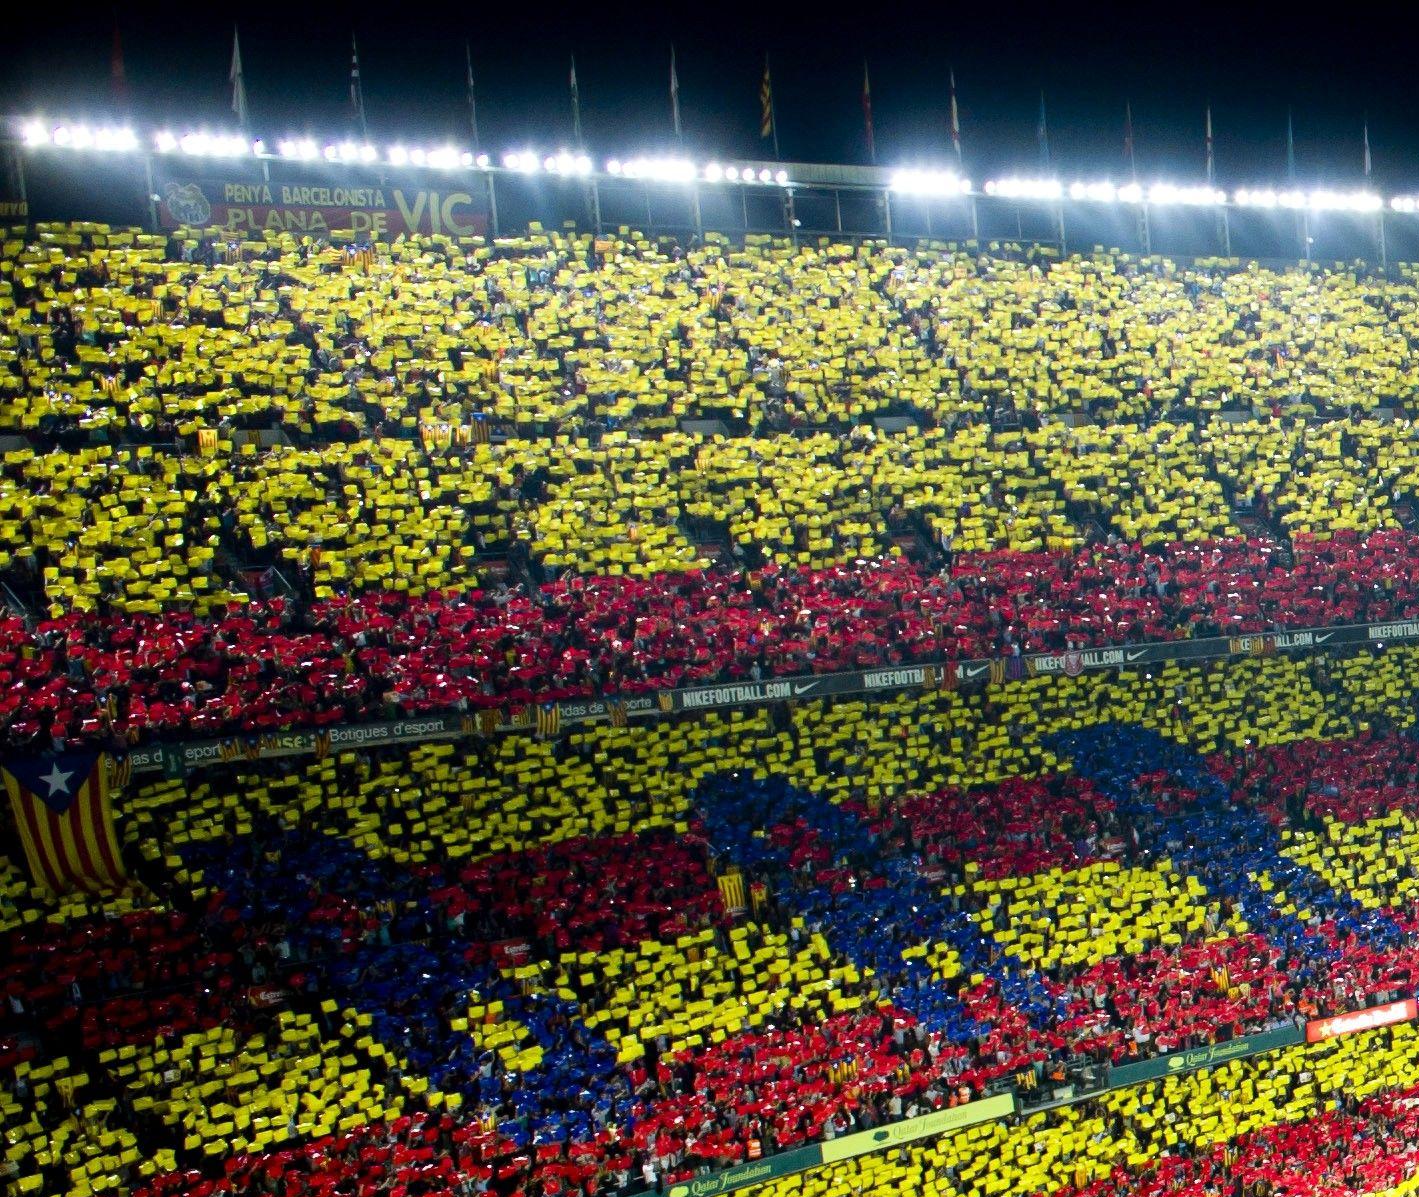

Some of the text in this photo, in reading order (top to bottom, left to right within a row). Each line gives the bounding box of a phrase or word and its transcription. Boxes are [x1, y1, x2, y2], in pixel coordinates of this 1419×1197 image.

[224, 183, 386, 208] PENYA BARCELONISTA
[226, 189, 476, 236] PLANA DE VIC
[683, 681, 792, 708] NIKEFOOTBALL.COM
[330, 720, 446, 744] Botigues d'esport
